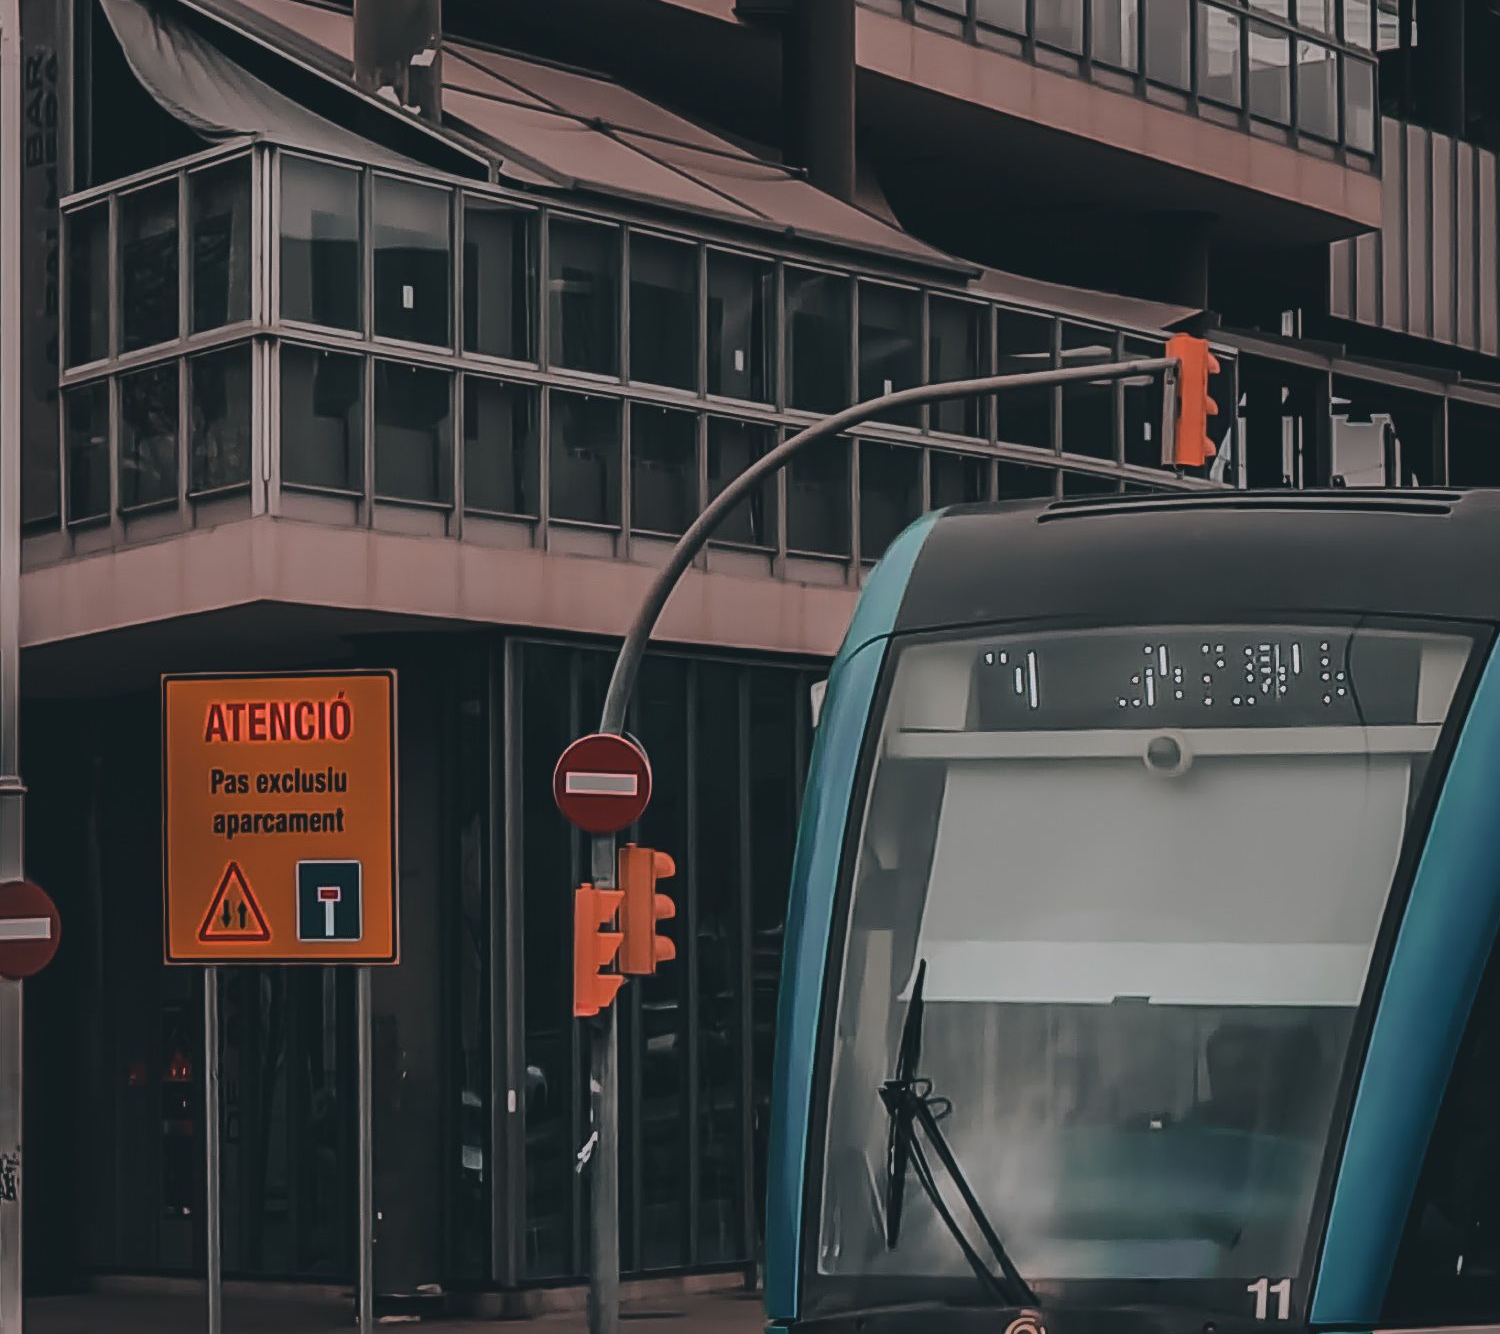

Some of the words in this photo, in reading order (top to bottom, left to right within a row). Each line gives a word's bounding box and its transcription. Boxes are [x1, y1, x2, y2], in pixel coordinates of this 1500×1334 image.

[205, 691, 351, 742] ATENCIÓ
[211, 768, 249, 794] Pas
[213, 808, 344, 839] aparcament
[1247, 1278, 1291, 1320] 11
